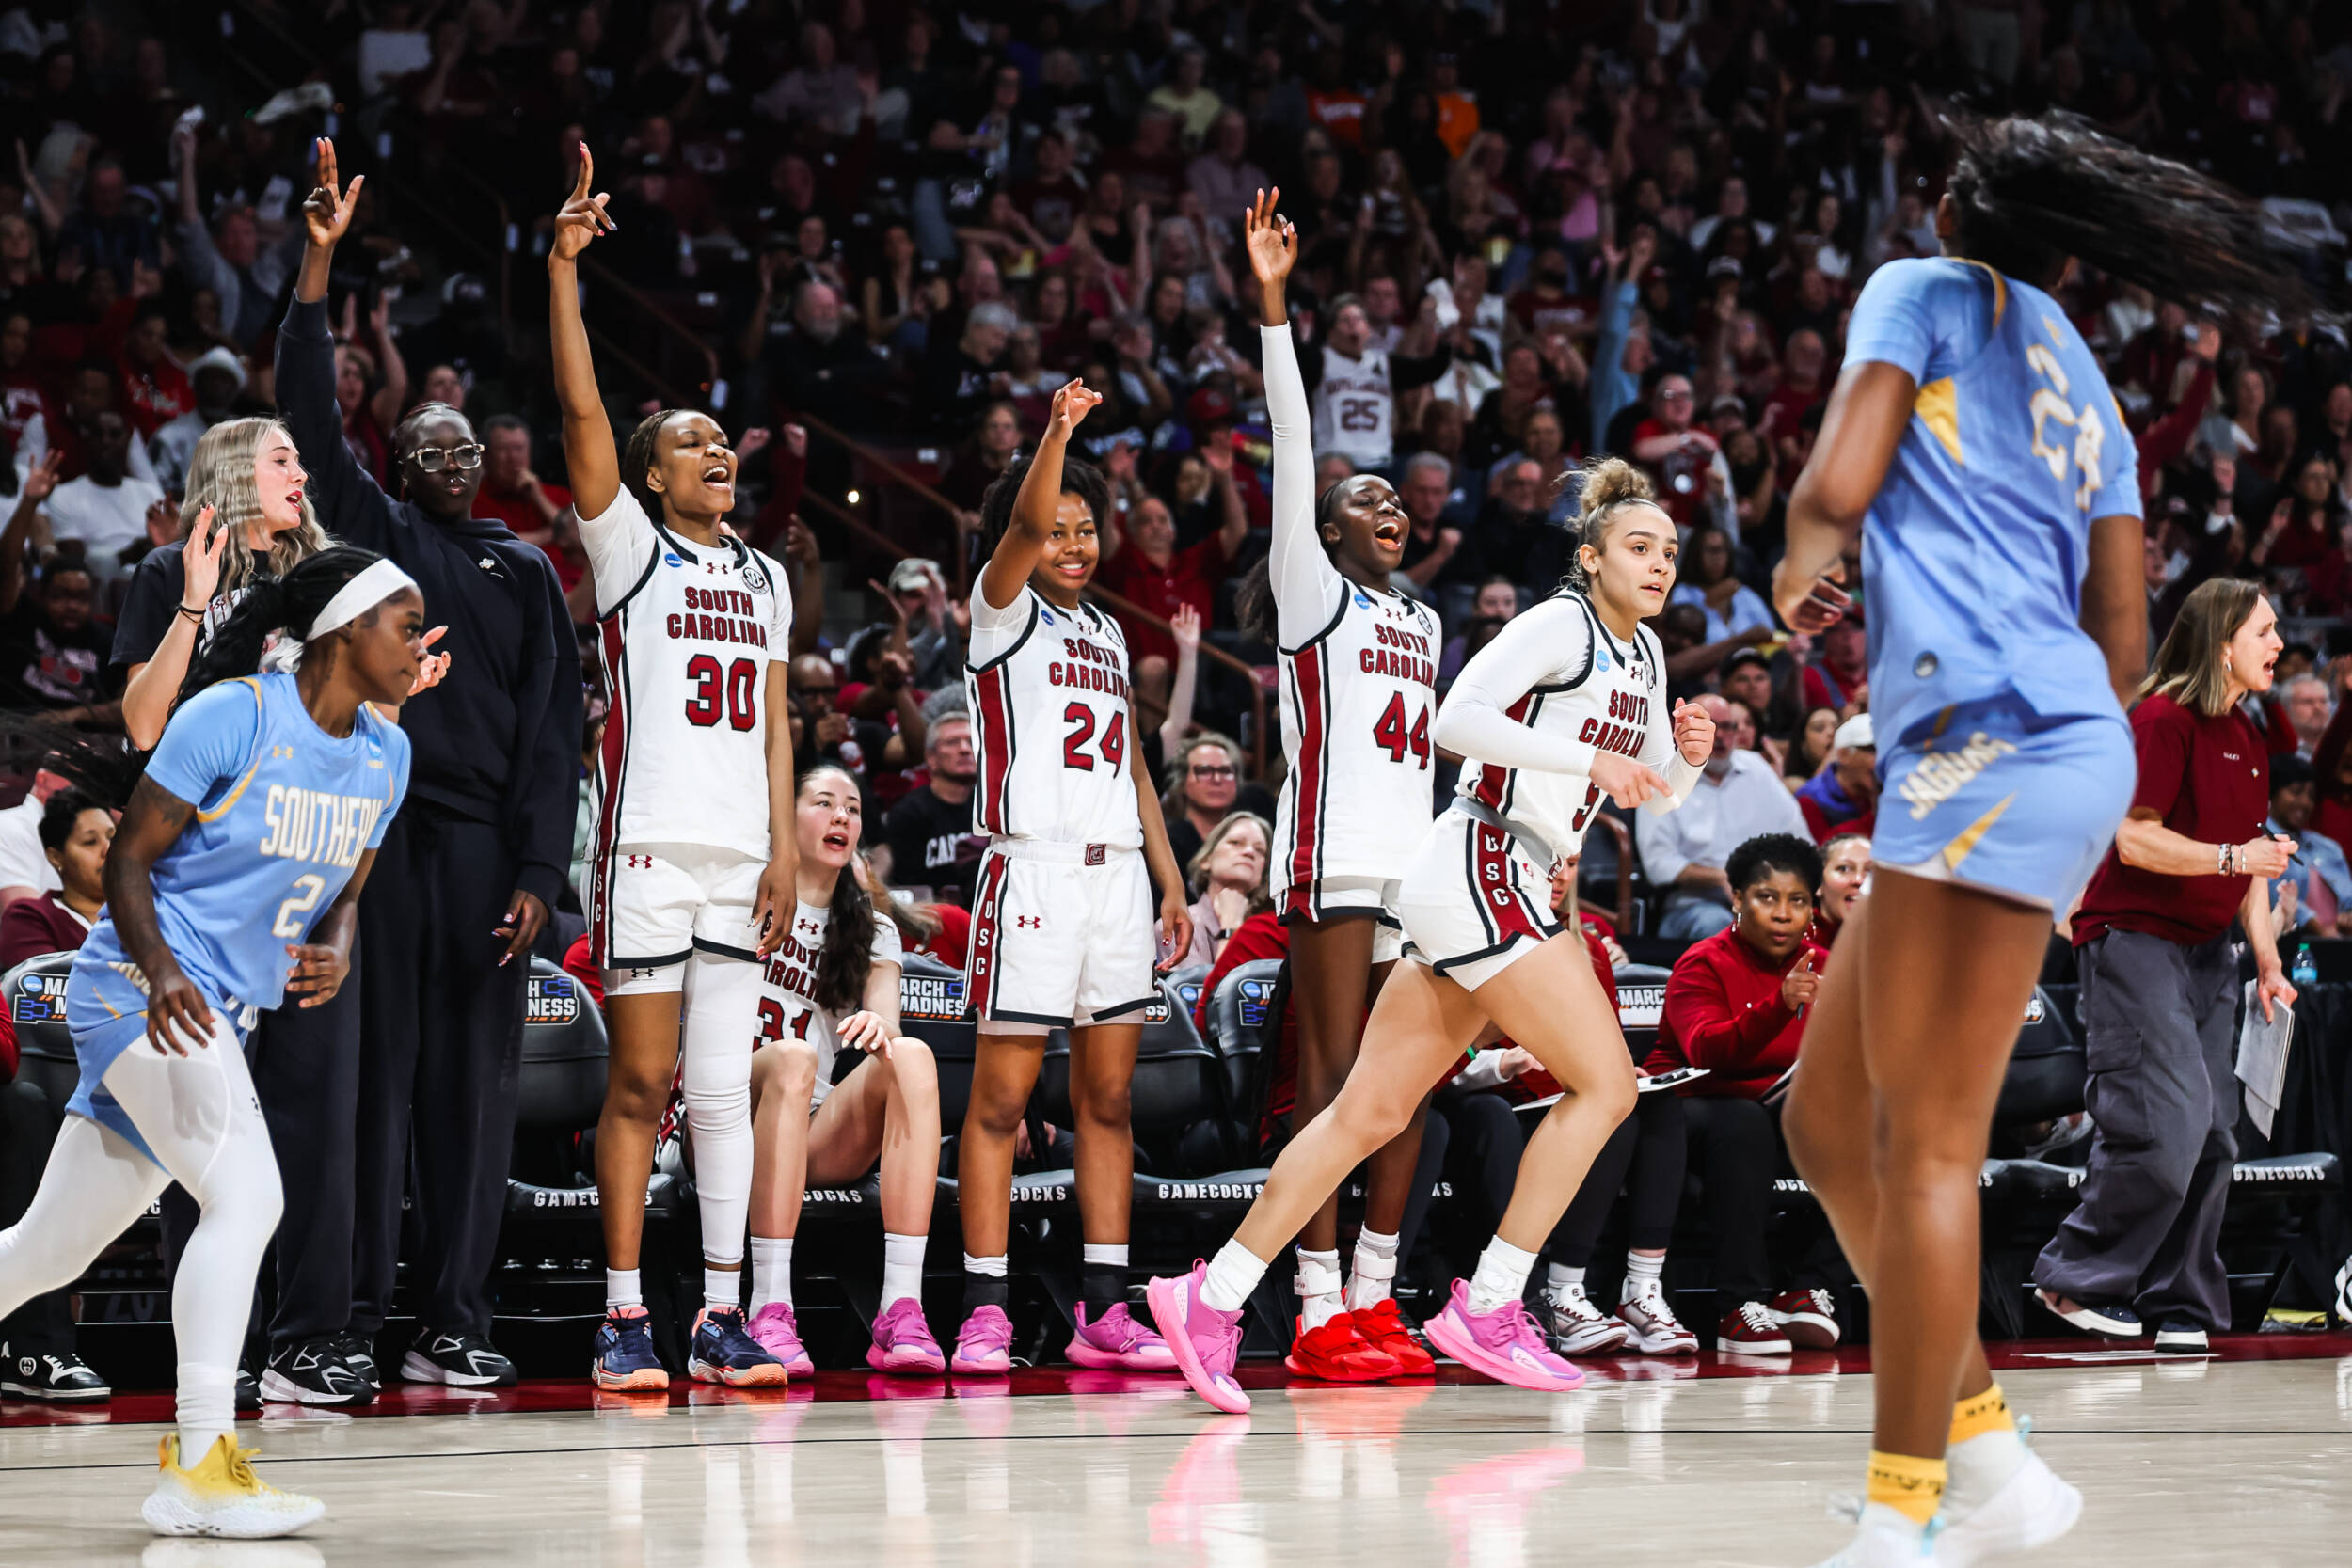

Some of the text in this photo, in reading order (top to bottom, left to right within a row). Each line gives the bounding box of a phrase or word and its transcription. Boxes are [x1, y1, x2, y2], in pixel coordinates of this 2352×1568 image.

[1342, 397, 1380, 432] 25
[684, 586, 754, 618] SOUTH
[1063, 637, 1120, 671] SOUTH
[1375, 623, 1431, 657] SOUTH
[1359, 648, 1437, 689] CAROLIN
[685, 653, 757, 733] 30
[1063, 701, 1124, 780] 24
[1373, 690, 1431, 770] 44
[271, 873, 326, 939] 2
[976, 900, 993, 975] USC
[899, 977, 946, 997] ARCH
[1617, 988, 1666, 1006] MARC
[527, 998, 576, 1017] NESS
[752, 995, 814, 1053] 31
[2233, 1164, 2326, 1182] GAMECOCKS
[802, 1188, 863, 1204] COCKS
[1009, 1186, 1067, 1202] COCKS
